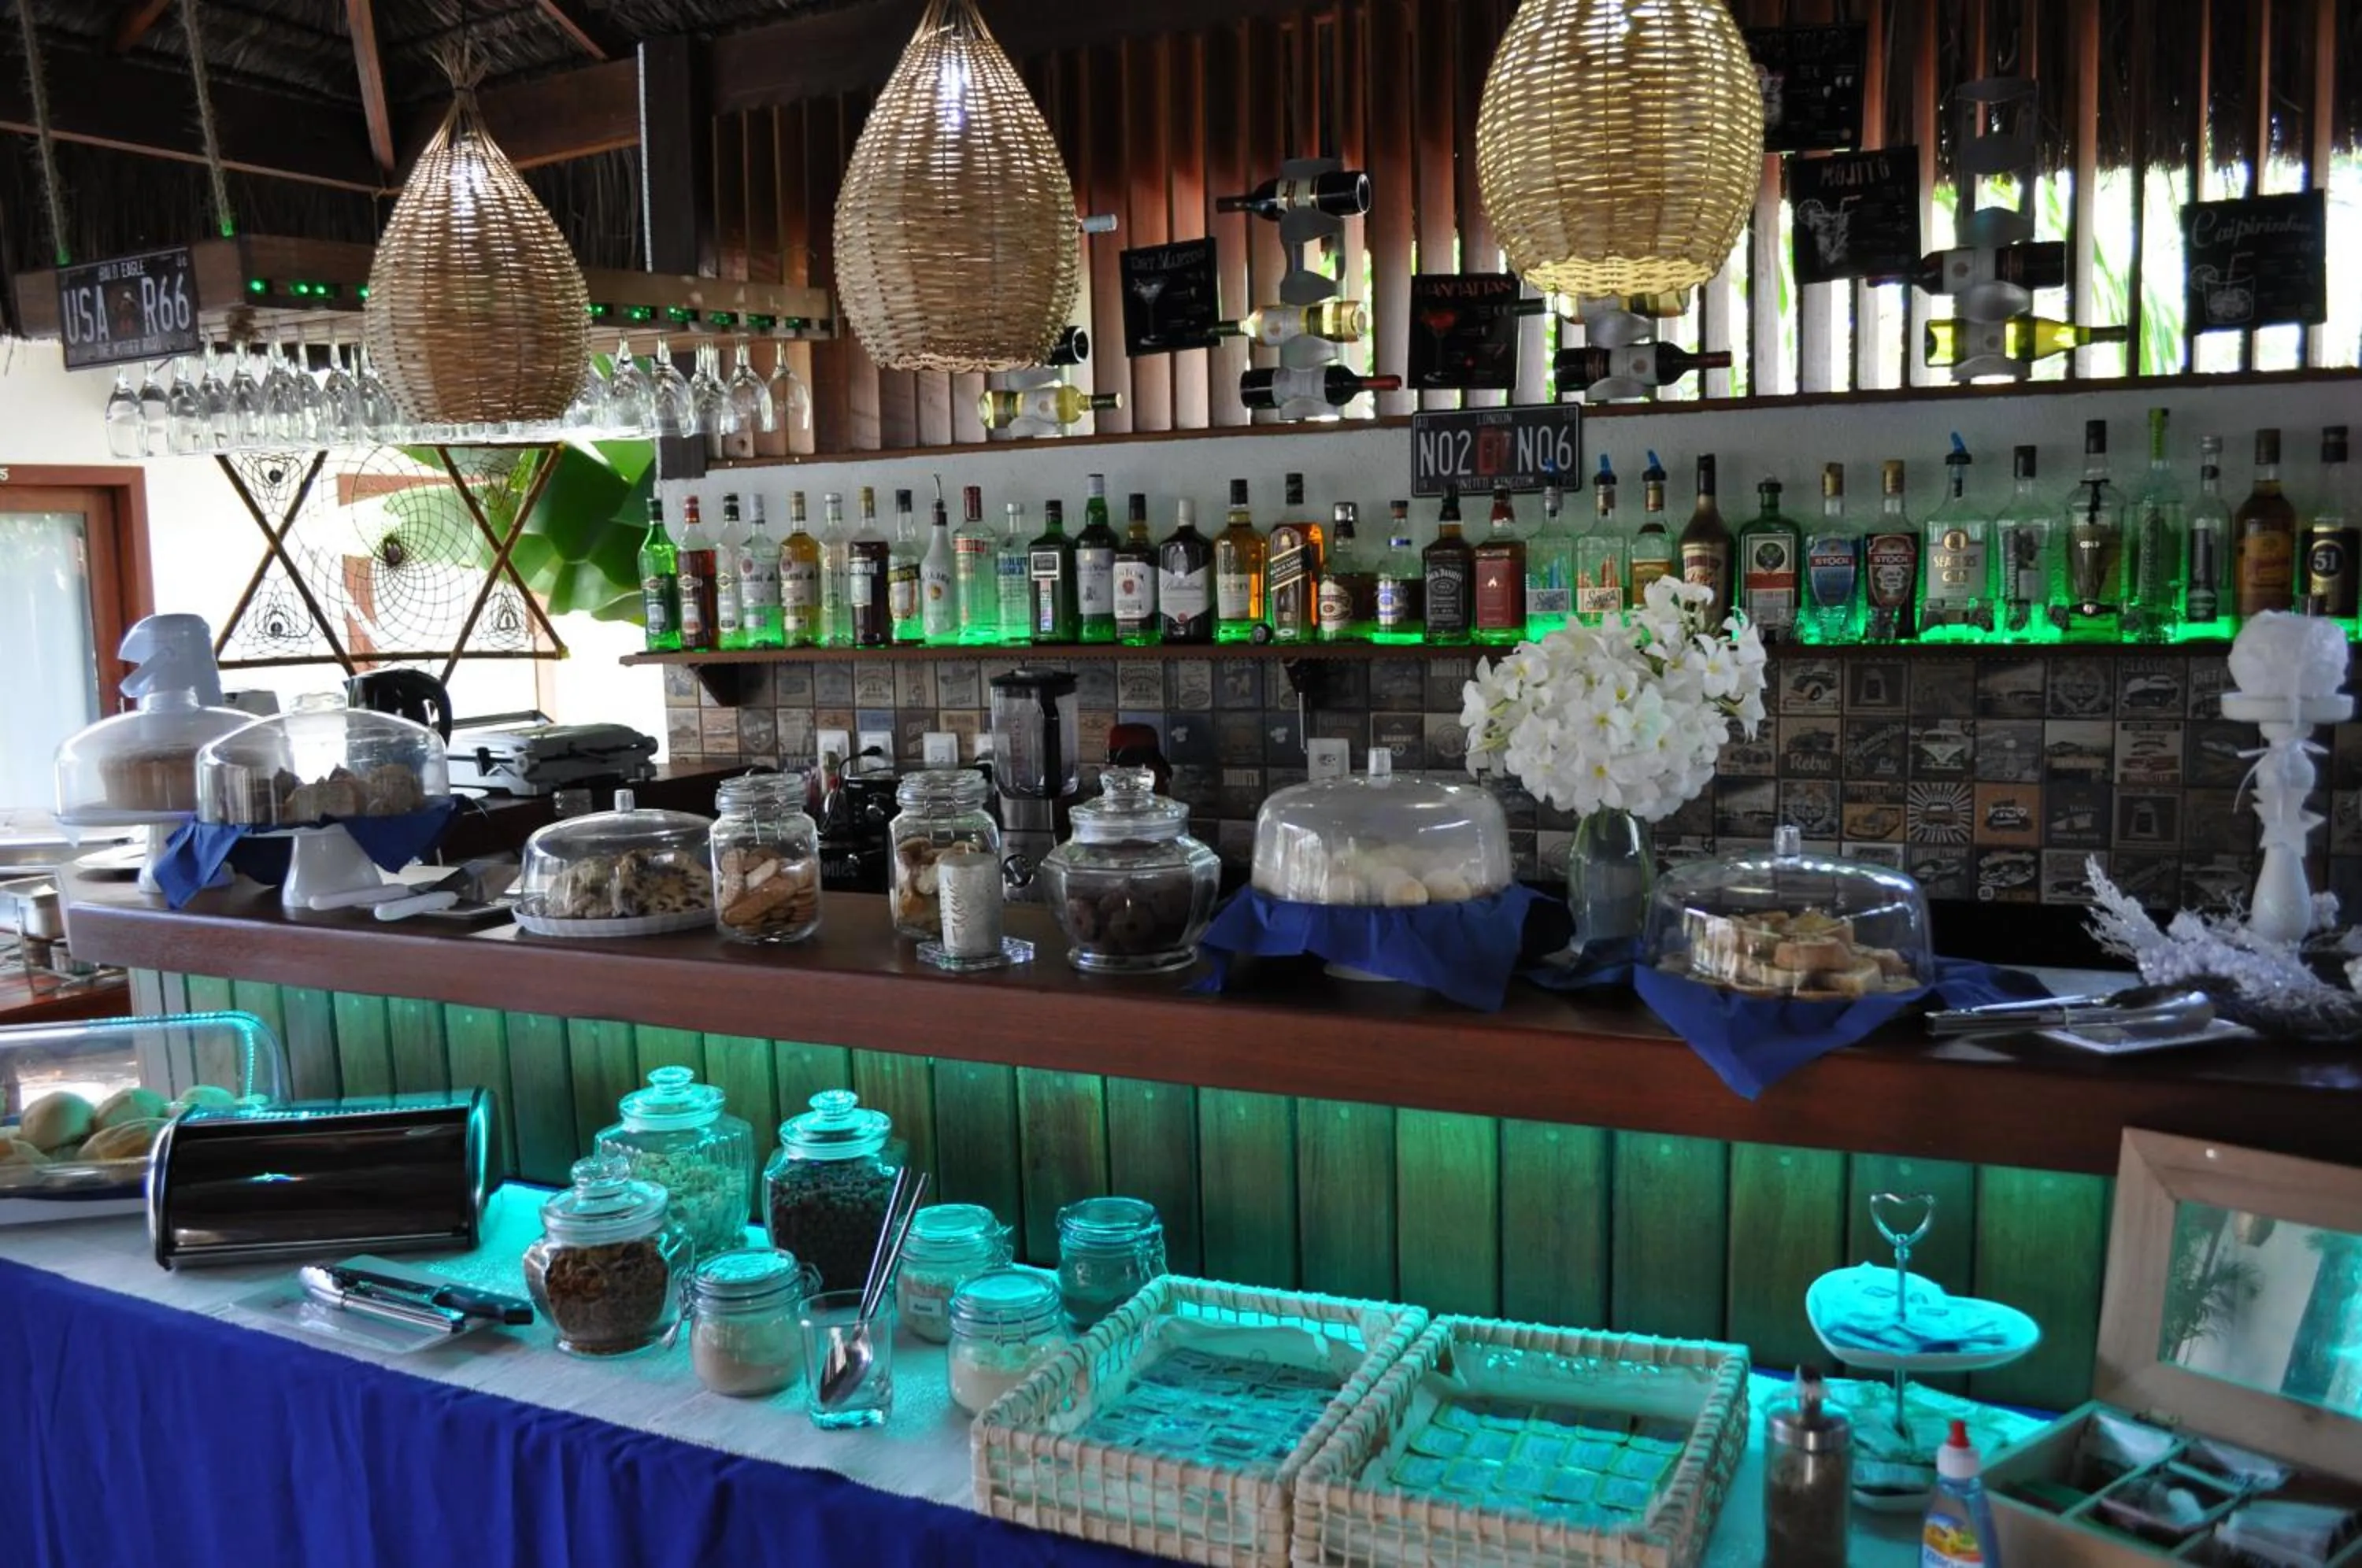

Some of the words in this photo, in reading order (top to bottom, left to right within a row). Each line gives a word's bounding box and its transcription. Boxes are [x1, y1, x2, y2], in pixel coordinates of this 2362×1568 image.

[63, 284, 110, 346] USA
[140, 272, 191, 337] R66
[1476, 412, 1513, 427] LONDON
[2313, 550, 2338, 571] 51
[1790, 752, 1832, 771] Retro
